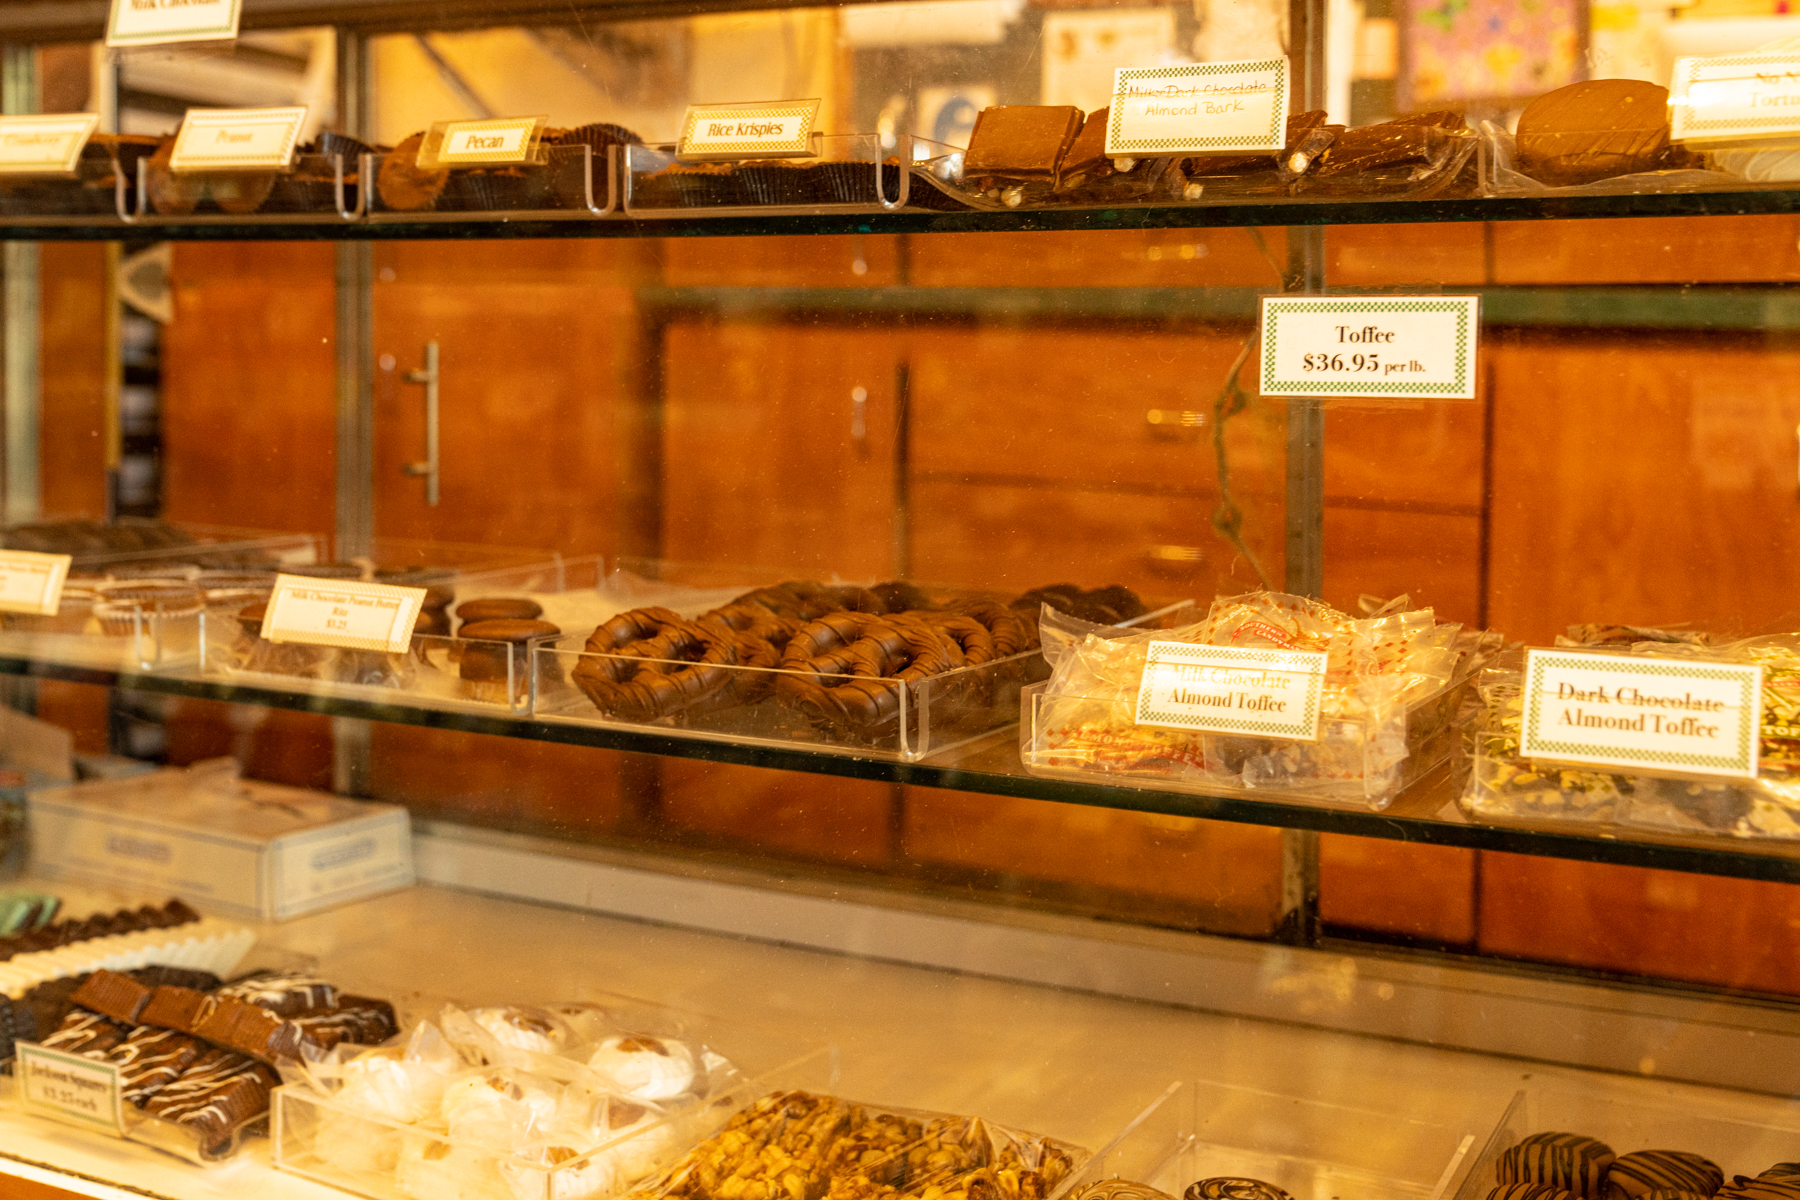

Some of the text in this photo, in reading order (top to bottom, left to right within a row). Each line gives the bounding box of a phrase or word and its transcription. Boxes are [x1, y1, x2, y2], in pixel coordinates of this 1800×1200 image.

[1164, 84, 1199, 98] Dark
[1145, 99, 1245, 116] Almond Bark
[707, 122, 784, 137] Rice Krispies
[466, 135, 504, 150] Pecan
[1335, 325, 1396, 343] Toffee
[1302, 352, 1426, 375] $36.95 per lb.
[1210, 668, 1291, 690] Chocolate
[1167, 688, 1287, 713] Almond Toffee
[1557, 681, 1725, 713] Dark Chocolate
[1558, 706, 1720, 739] Almond Toffee
